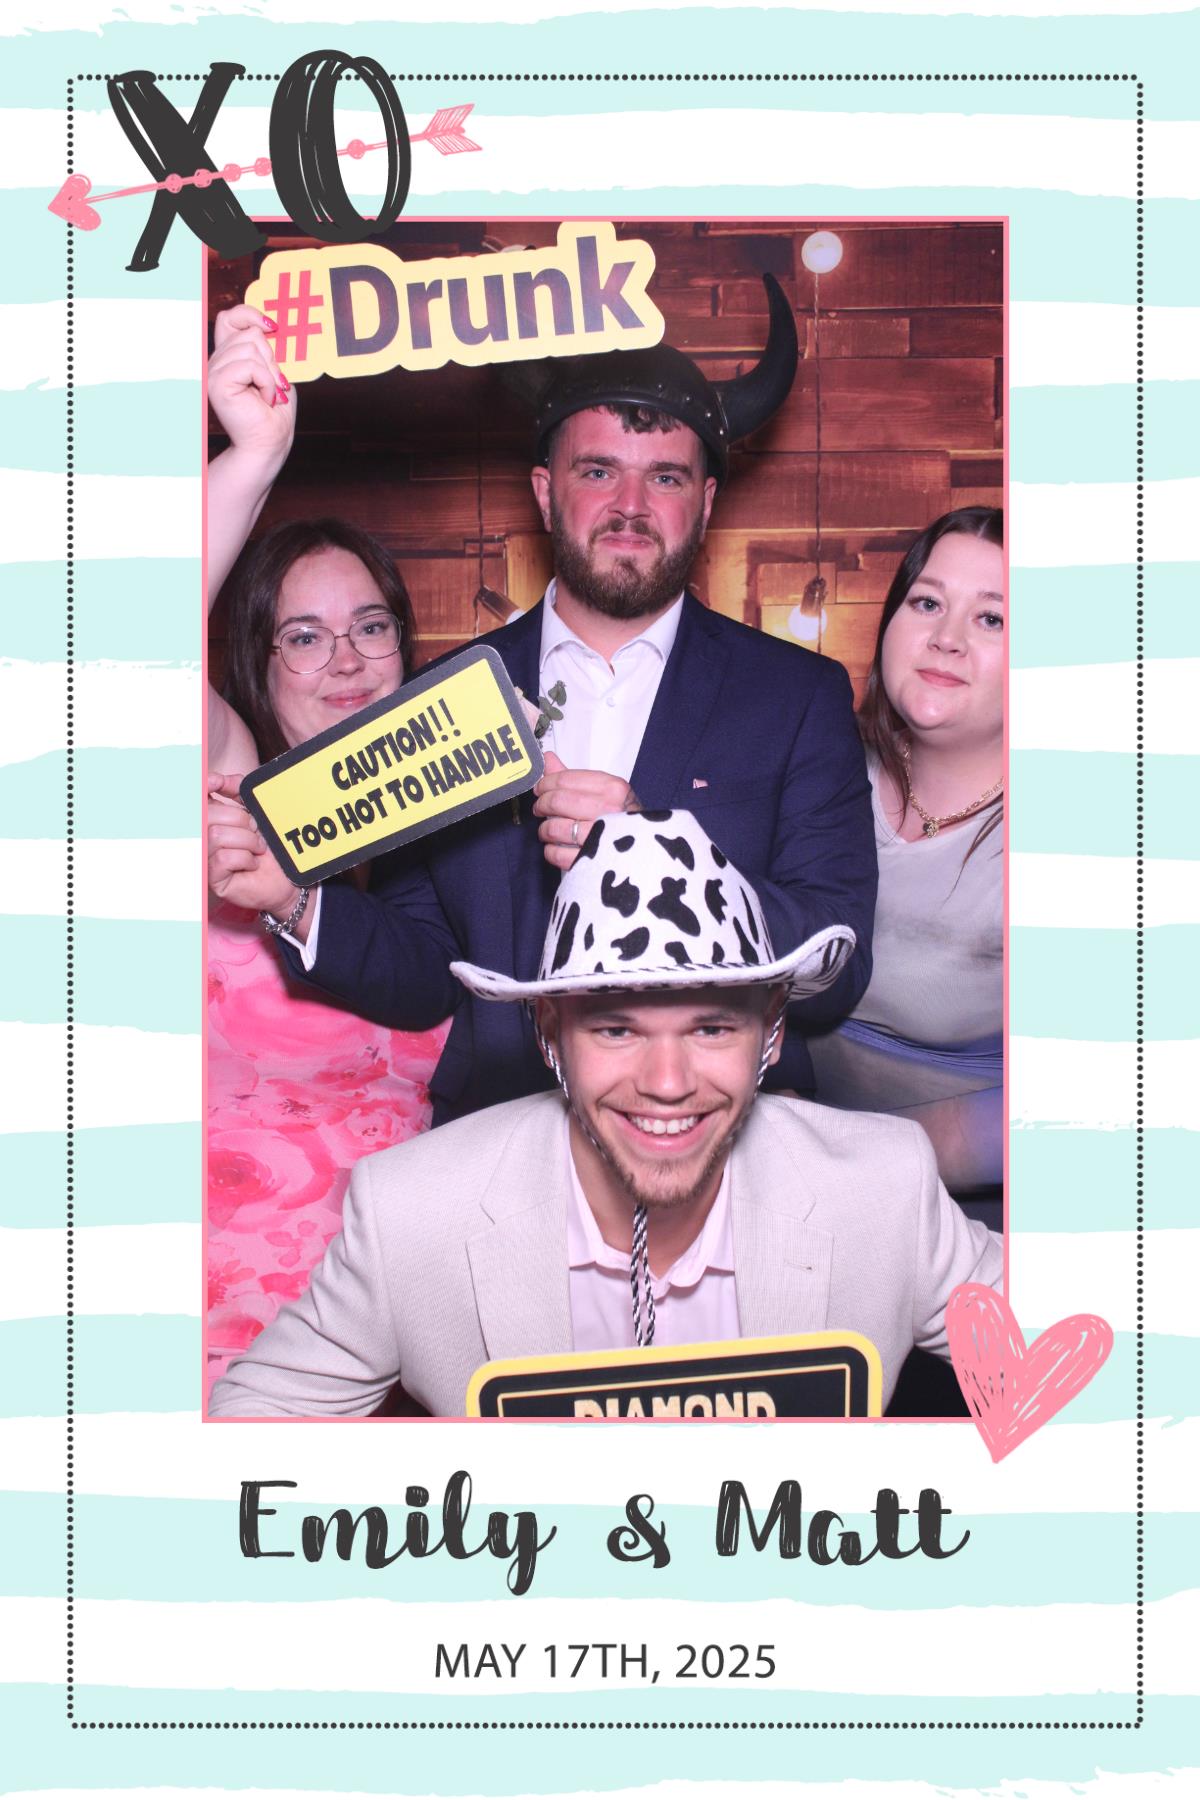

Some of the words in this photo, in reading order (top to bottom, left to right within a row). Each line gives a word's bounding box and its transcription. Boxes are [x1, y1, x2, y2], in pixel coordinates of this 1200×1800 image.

[264, 236, 645, 361] #Drunk
[285, 816, 338, 854] TOO
[336, 789, 388, 833] HOT
[386, 774, 423, 810] TO
[421, 724, 523, 796] HANDLE
[332, 699, 461, 790] CAUTION!!
